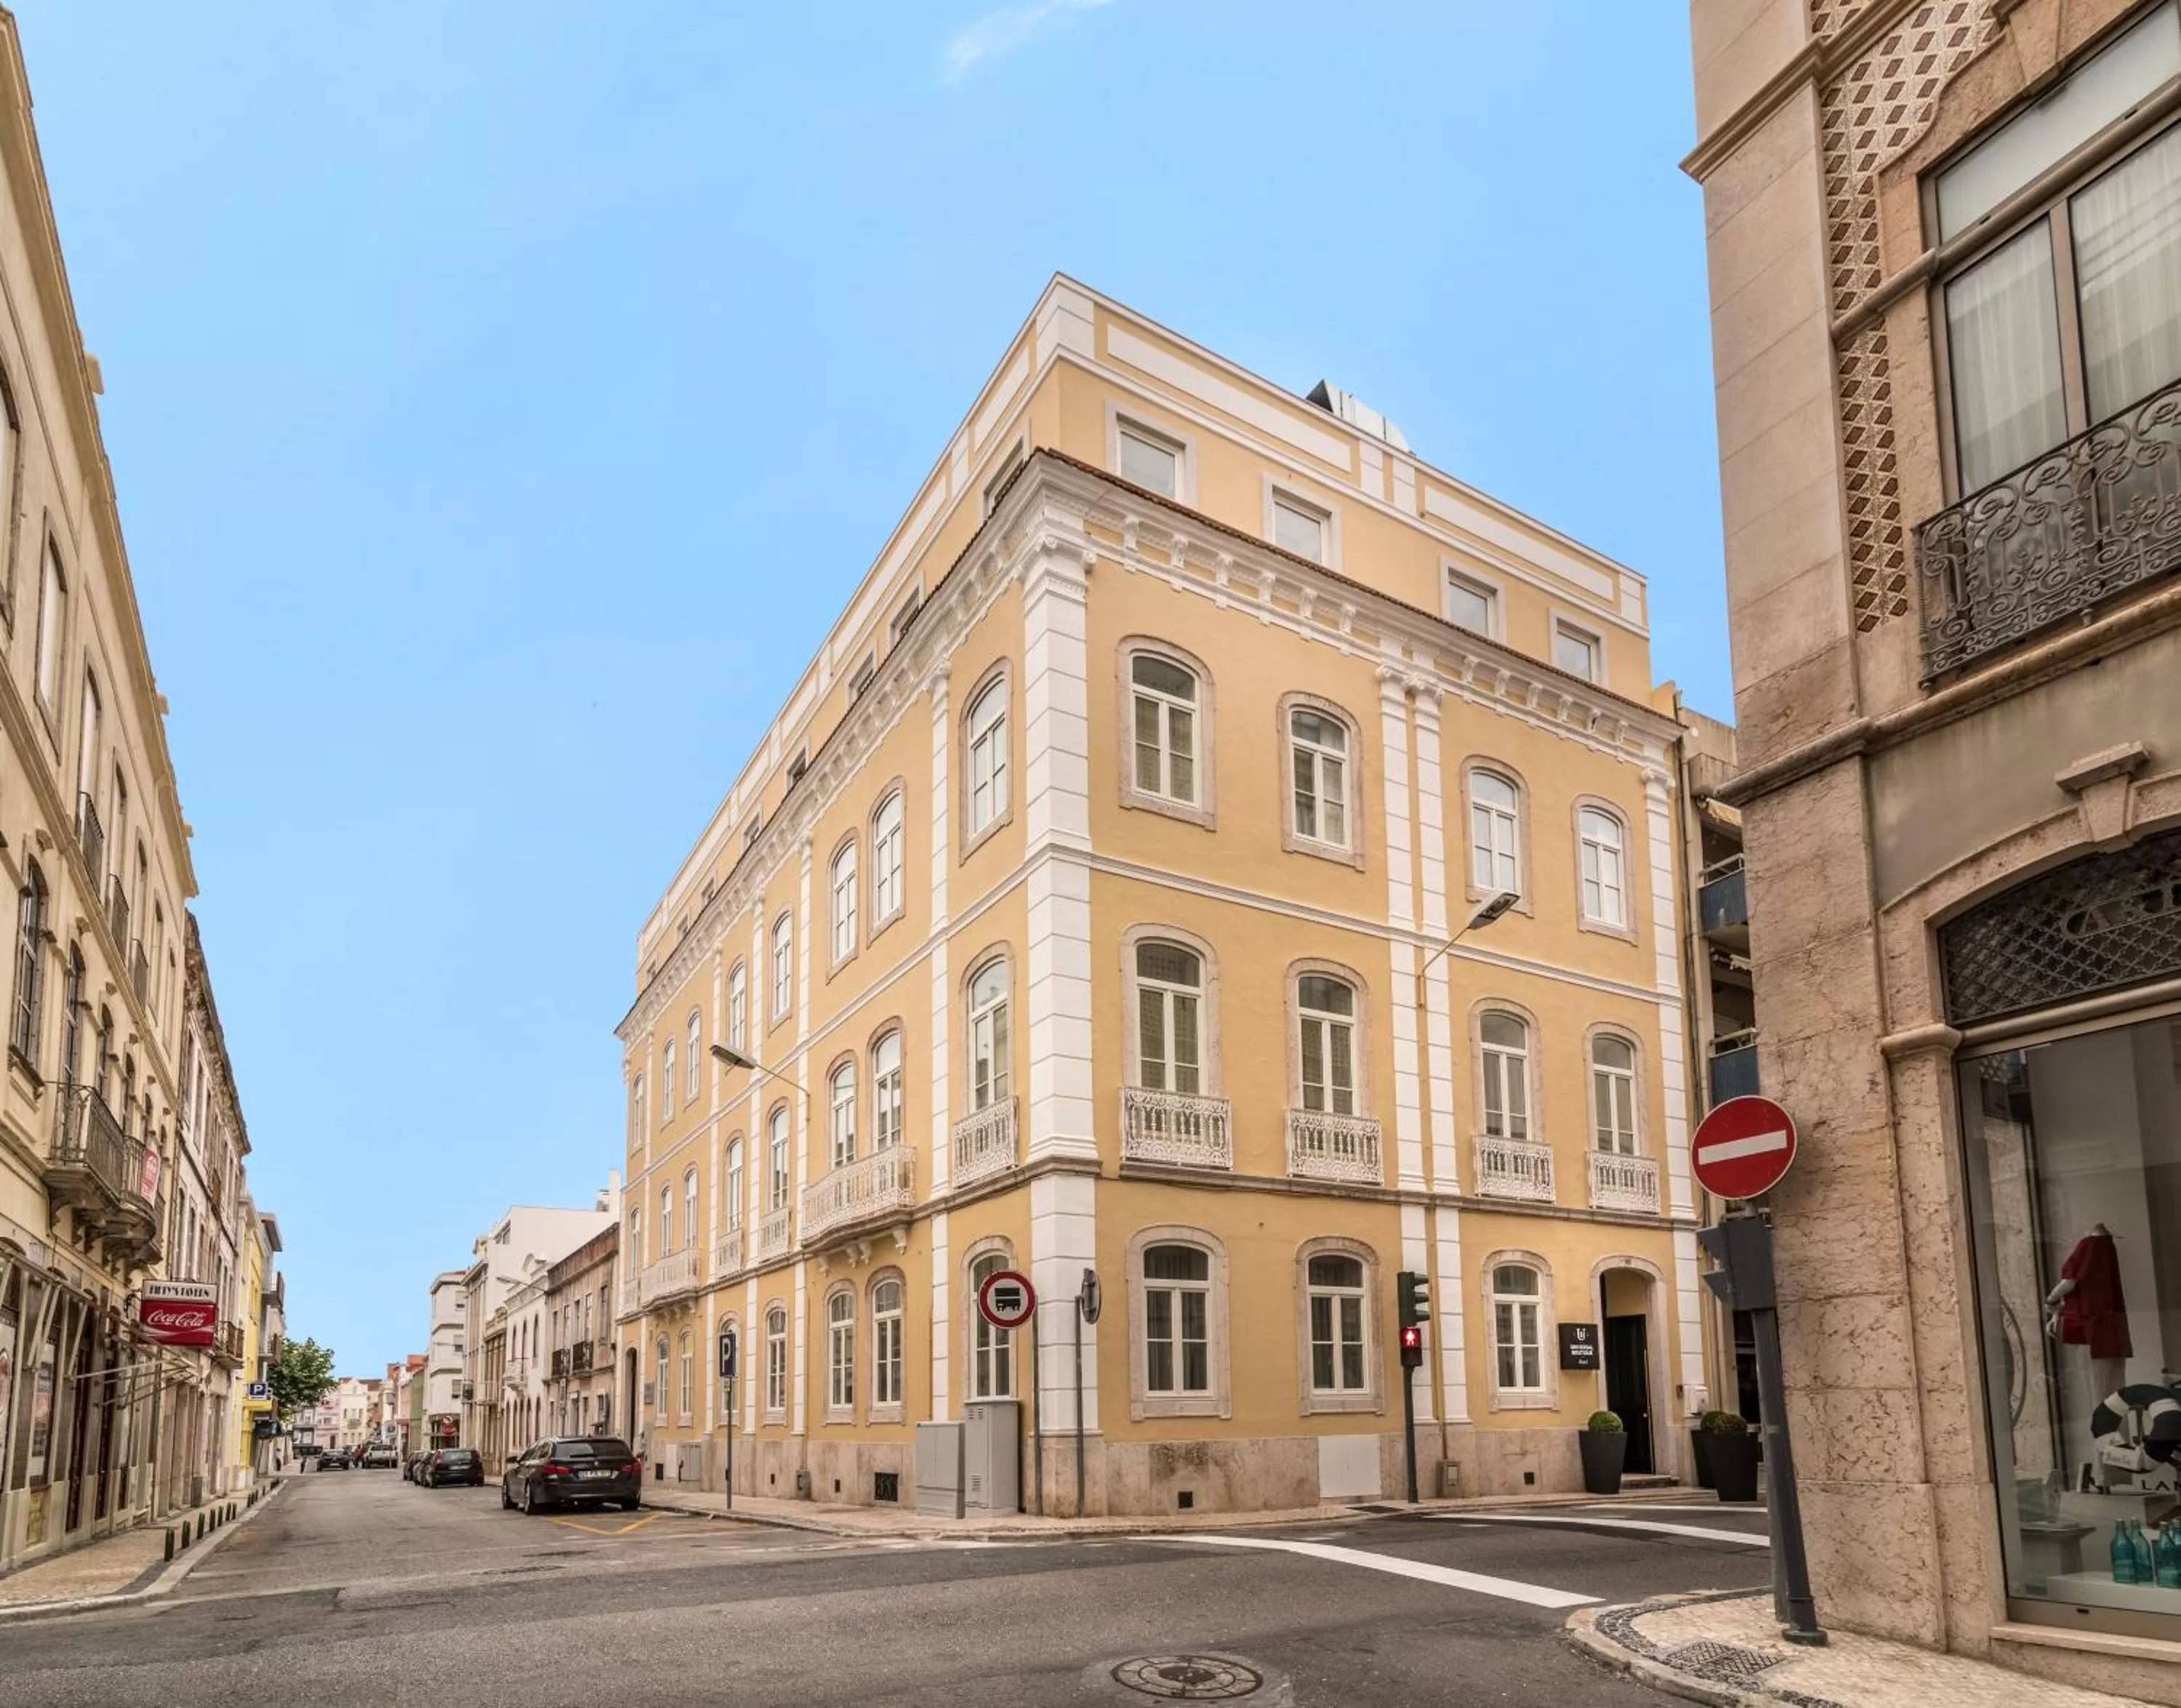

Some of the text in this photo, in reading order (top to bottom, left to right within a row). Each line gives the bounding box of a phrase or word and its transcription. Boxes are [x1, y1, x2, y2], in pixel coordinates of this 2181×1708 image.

[148, 1309, 206, 1326] Coca-Cola
[723, 1338, 731, 1373] P
[254, 1385, 263, 1395] P
